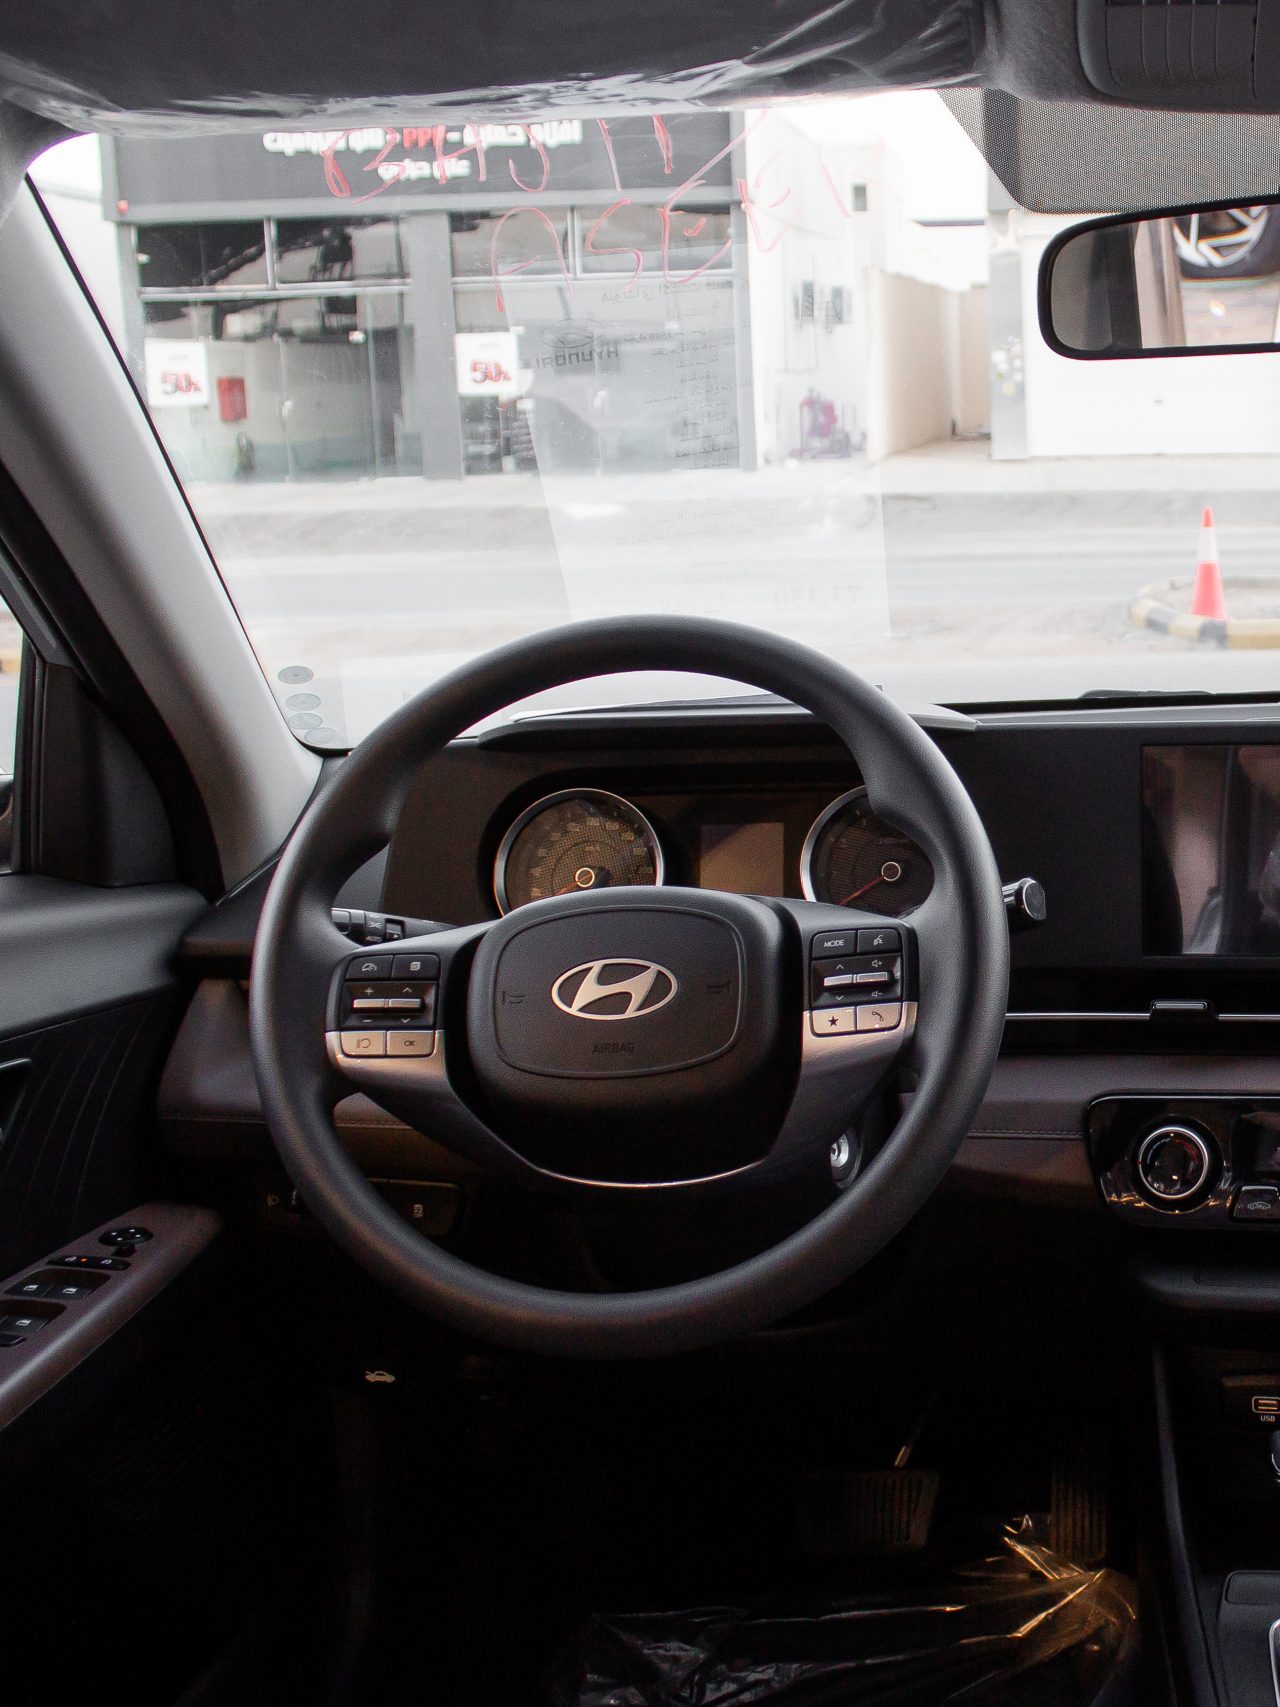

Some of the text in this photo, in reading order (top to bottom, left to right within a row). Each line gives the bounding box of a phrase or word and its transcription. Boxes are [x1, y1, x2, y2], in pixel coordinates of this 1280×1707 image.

[823, 939, 845, 948] MODE
[403, 1039, 416, 1047] OK
[592, 1041, 635, 1055] AIRBAG
